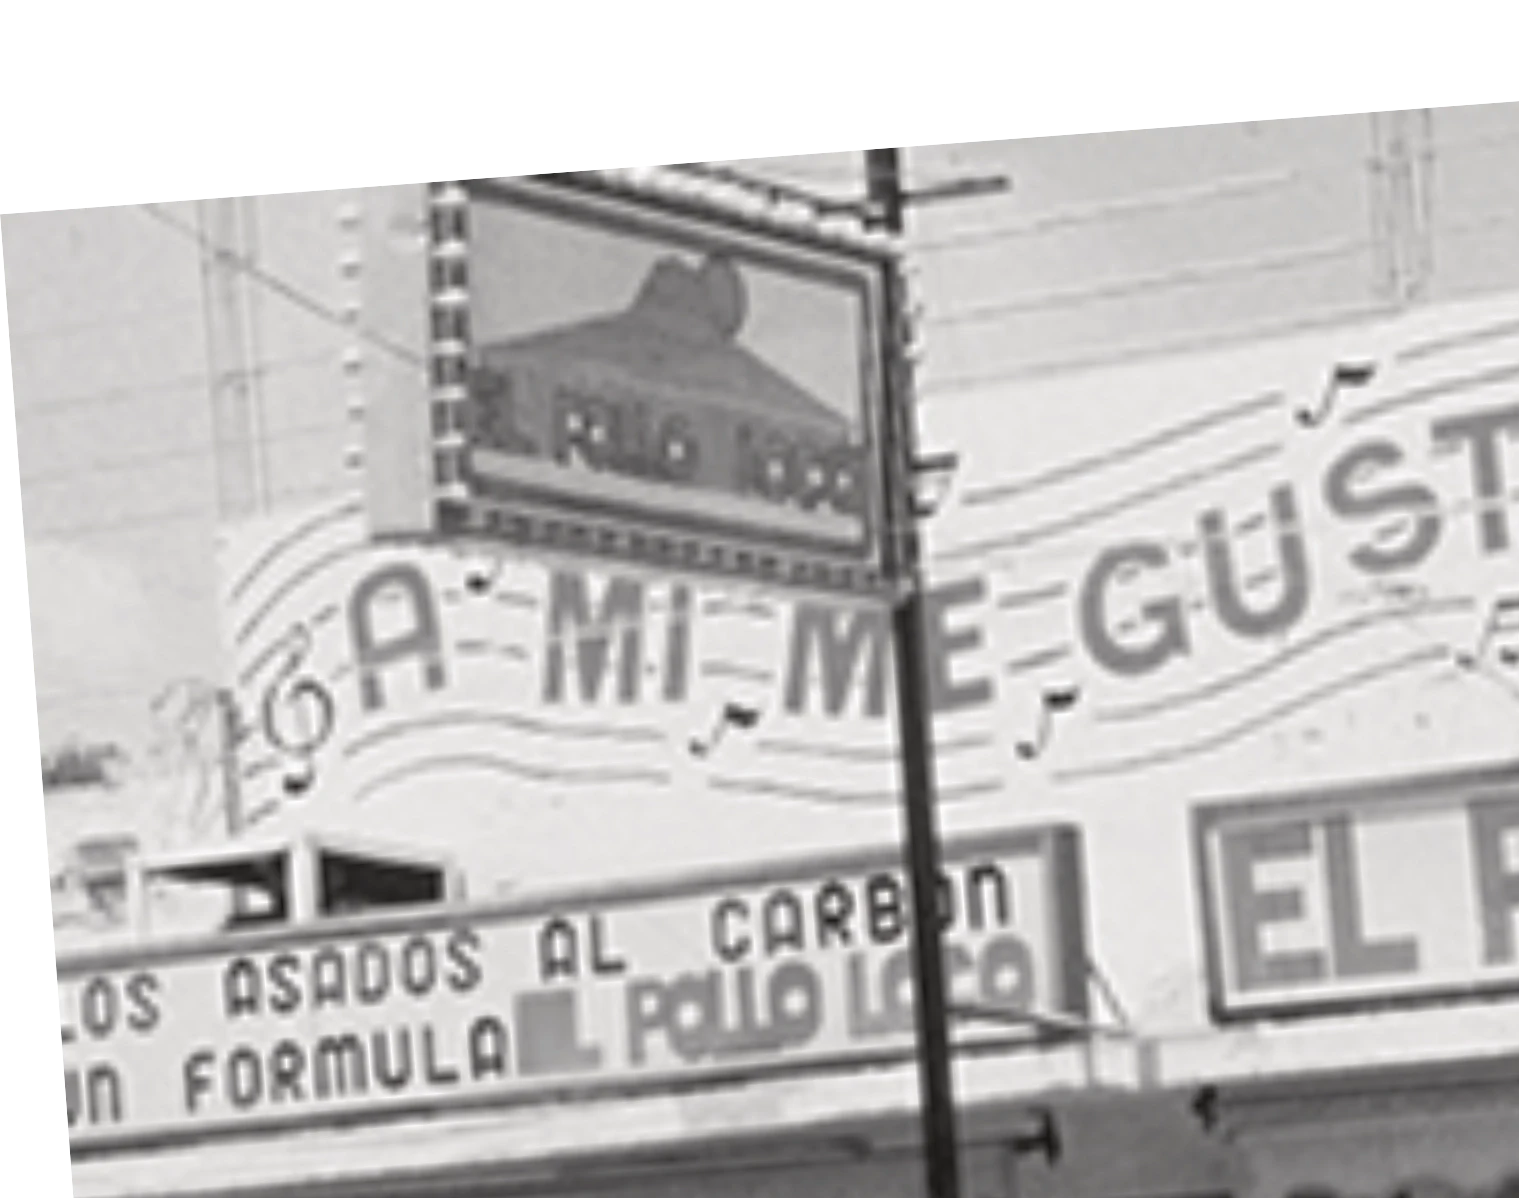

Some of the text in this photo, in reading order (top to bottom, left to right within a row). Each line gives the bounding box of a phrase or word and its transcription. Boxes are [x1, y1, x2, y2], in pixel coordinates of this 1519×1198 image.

[344, 560, 447, 711] A
[540, 569, 692, 704] MI
[782, 576, 995, 718] ME
[222, 924, 483, 1020] ASADOS
[537, 914, 628, 984] AL
[1214, 808, 1420, 994] EL
[183, 1014, 510, 1114] FORMULA
[624, 959, 826, 1067] POLLO
